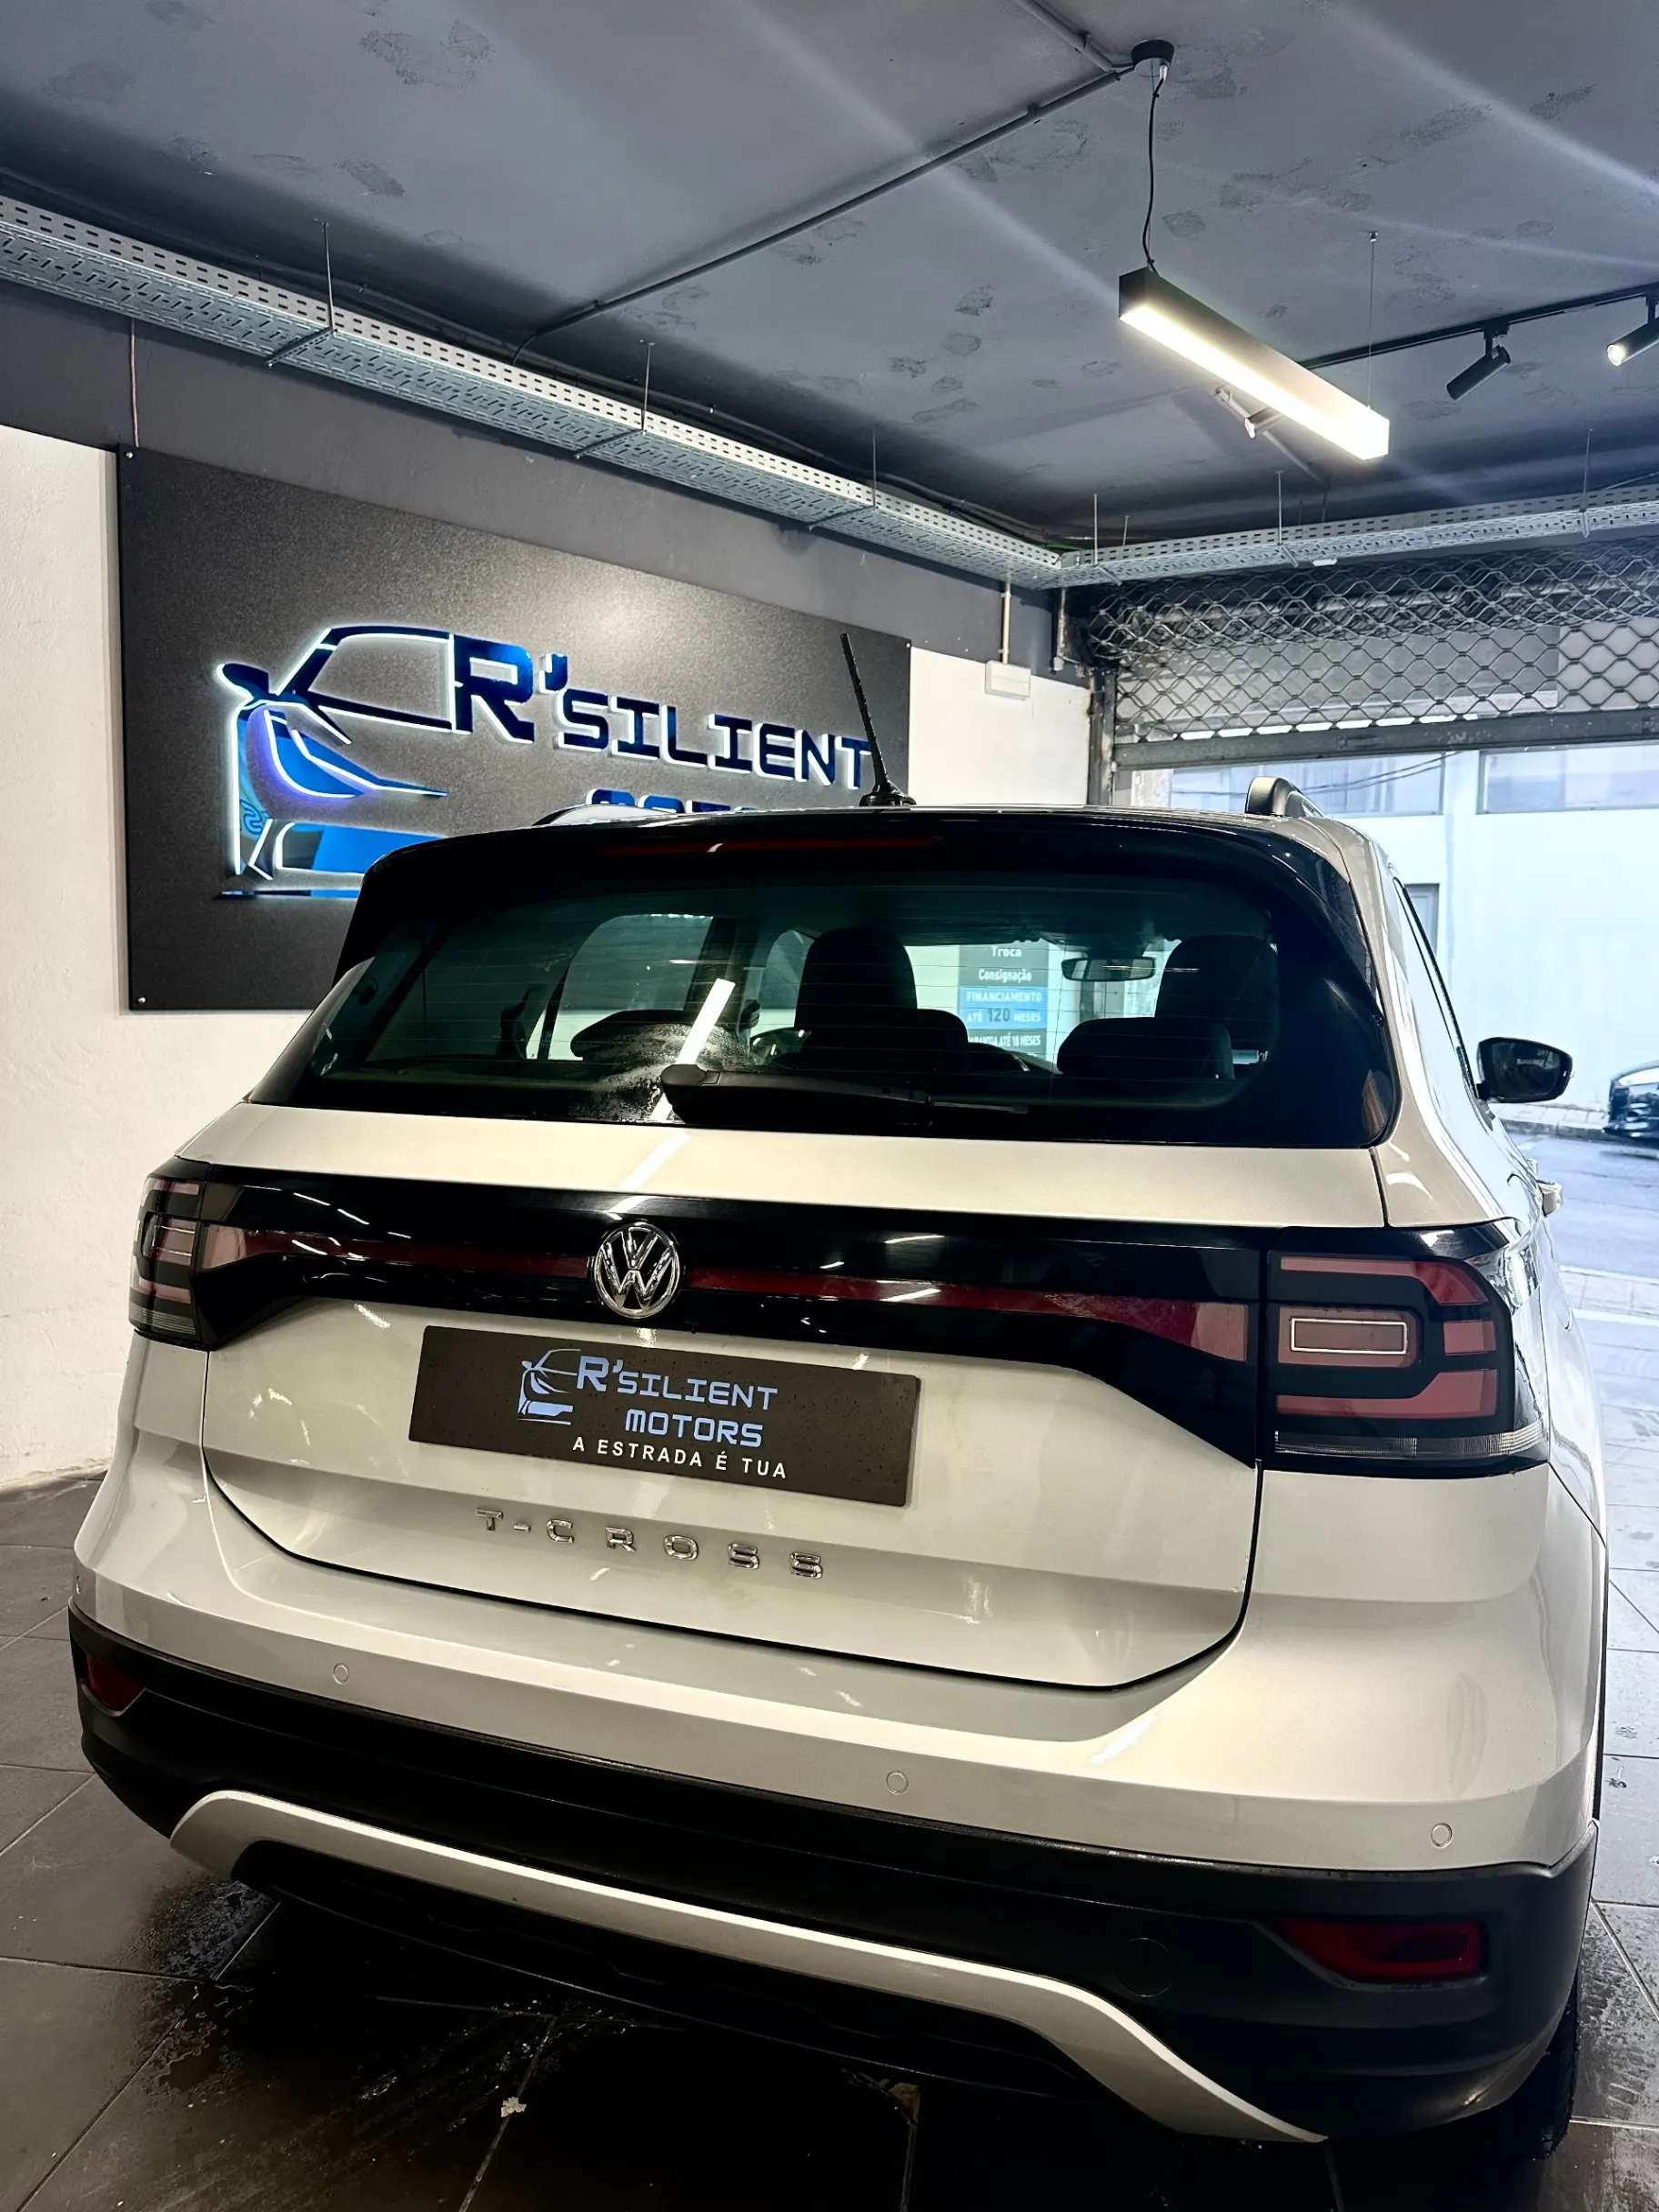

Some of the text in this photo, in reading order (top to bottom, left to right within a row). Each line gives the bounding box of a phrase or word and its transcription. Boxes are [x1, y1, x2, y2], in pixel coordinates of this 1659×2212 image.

[450, 634, 871, 789] R'SILIENT
[991, 946, 1022, 958] Troca
[979, 969, 1032, 983] Consignação
[966, 990, 1042, 1002] FINANCIAMENTO
[967, 1008, 1041, 1022] ATÉ 120 MESES
[1020, 1035, 1041, 1046] MESES
[577, 1355, 779, 1411] R'SILIENT
[625, 1409, 764, 1448] MOTORS
[573, 1436, 787, 1479] A ESTRADA É TUA
[475, 1508, 823, 1580] T-CROSS
